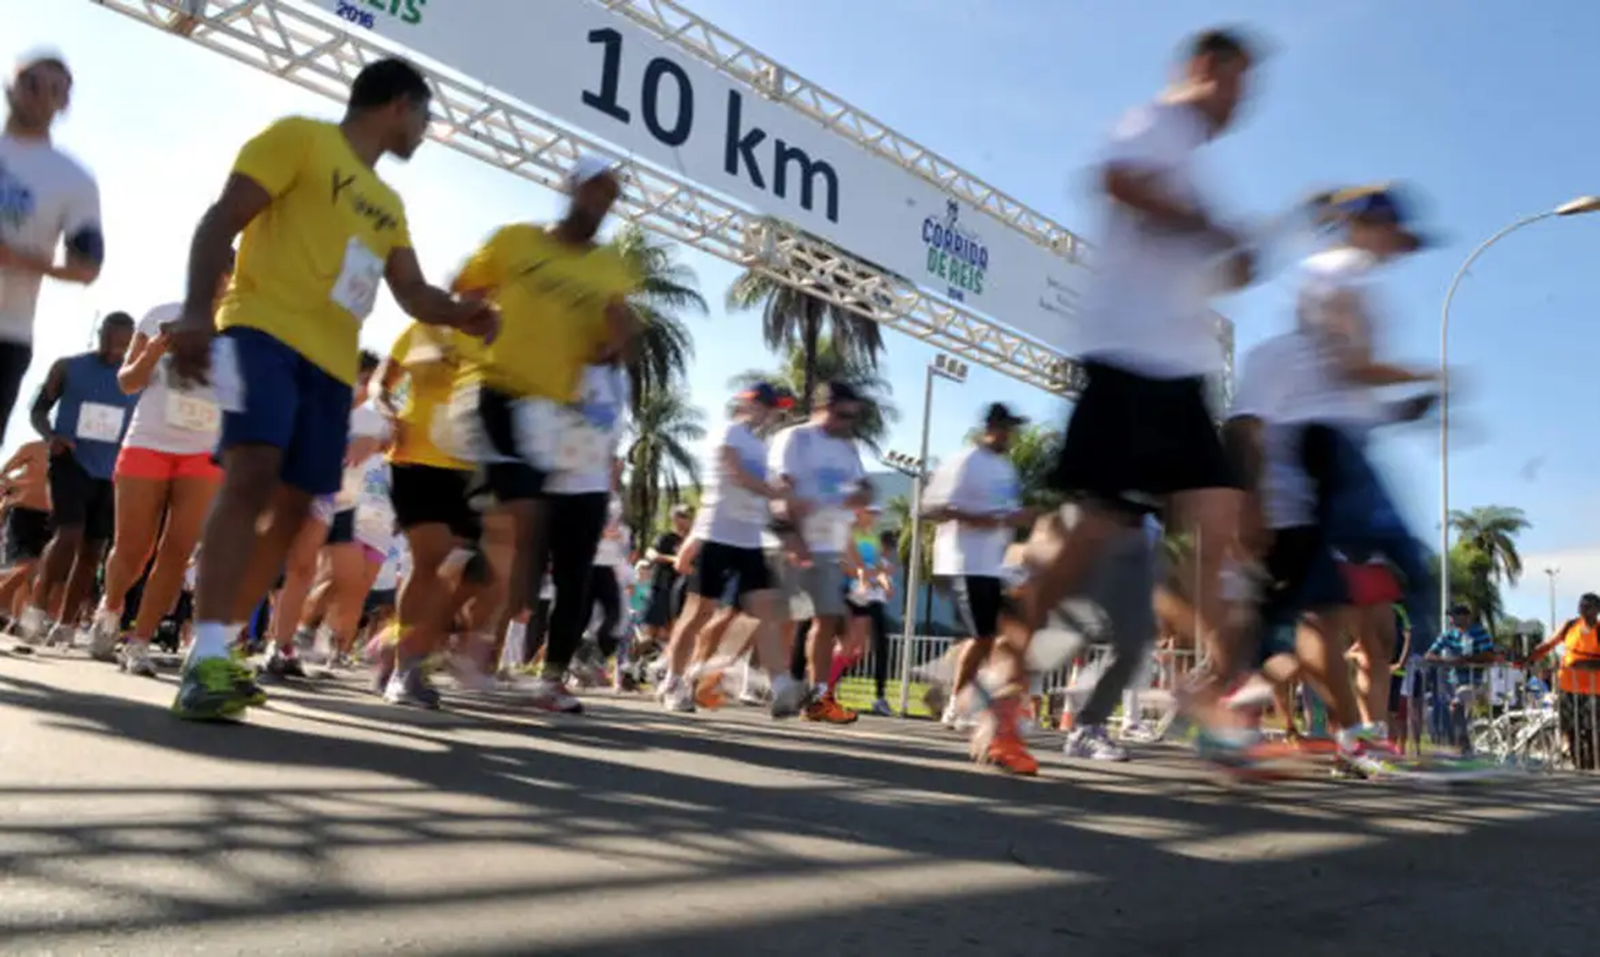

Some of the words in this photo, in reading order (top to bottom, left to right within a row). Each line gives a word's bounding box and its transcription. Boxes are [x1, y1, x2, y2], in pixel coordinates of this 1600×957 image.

[336, 1, 374, 29] 2016
[581, 27, 694, 147] 10
[724, 89, 839, 224] km
[922, 218, 989, 270] CORRIDA
[927, 247, 947, 279] DE
[949, 258, 984, 295] REIS
